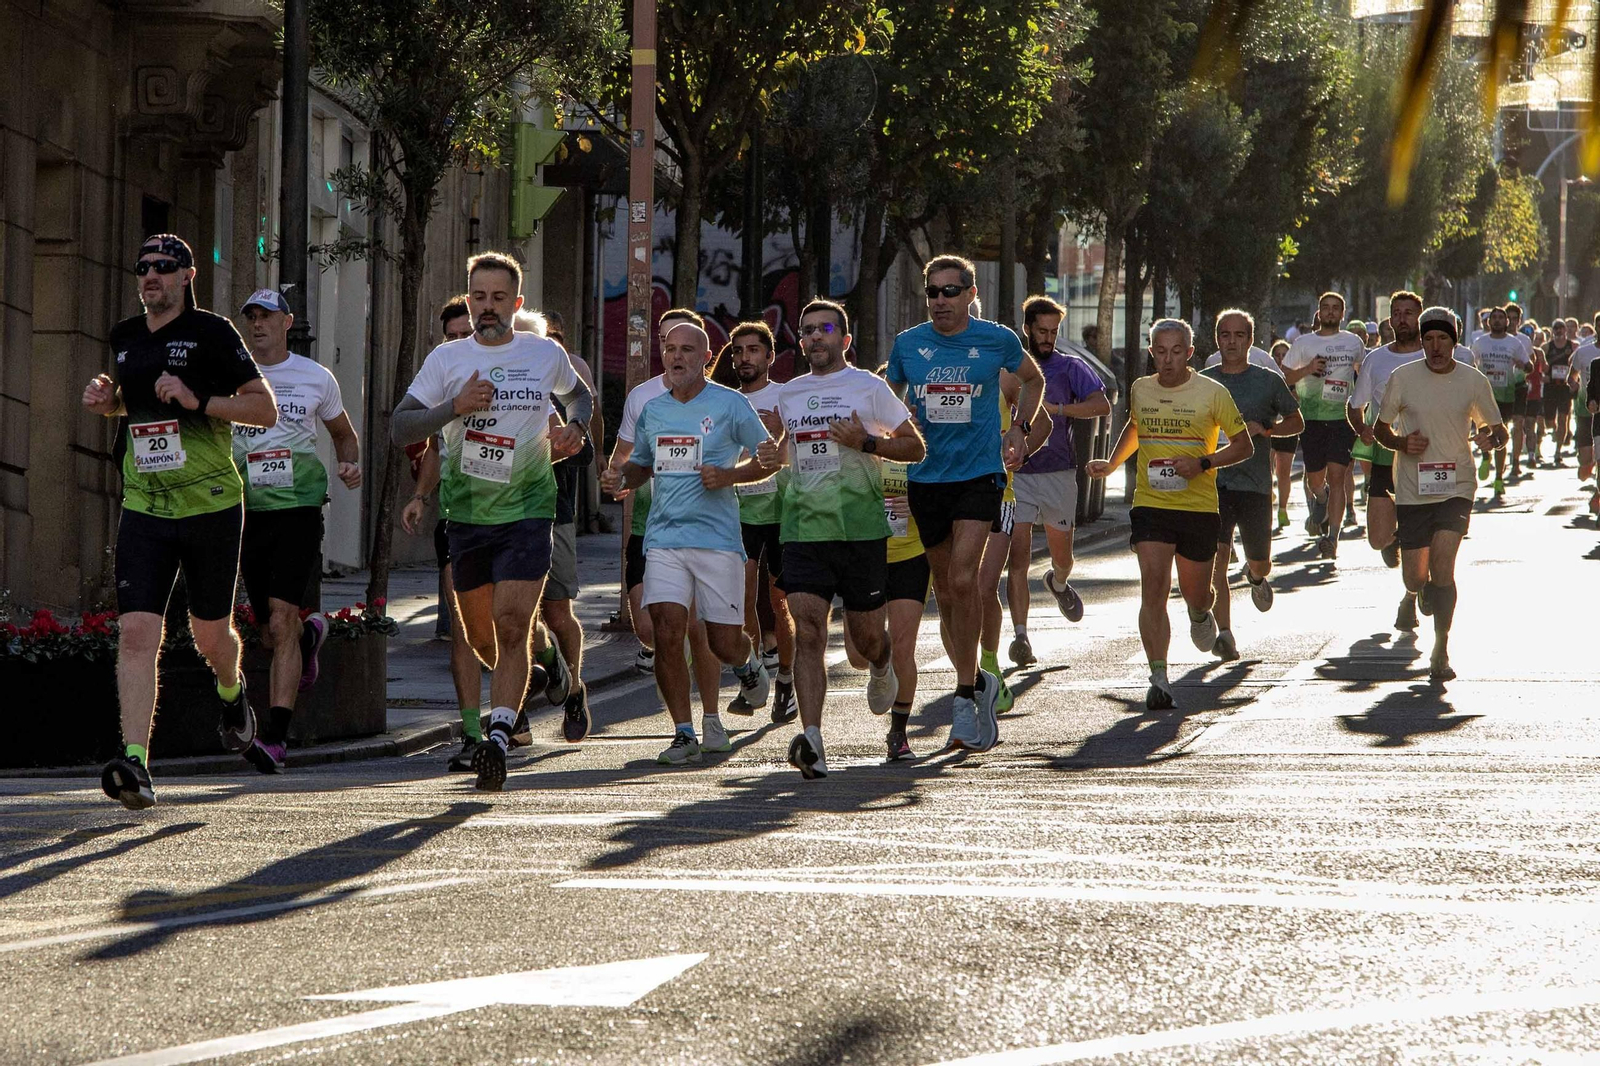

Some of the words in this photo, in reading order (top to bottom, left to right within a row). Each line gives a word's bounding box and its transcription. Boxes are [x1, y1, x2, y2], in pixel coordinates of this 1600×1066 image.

[926, 366, 971, 382] 42K
[940, 395, 964, 406] 259
[491, 404, 500, 412] el
[501, 403, 532, 411] cáncer
[463, 415, 497, 431] Vigo
[1141, 417, 1191, 427] ATHLETICS
[148, 437, 168, 451] 20
[812, 442, 828, 454] 83
[479, 446, 505, 461] 319
[669, 447, 688, 457] 199
[262, 461, 287, 472] 294
[1160, 468, 1180, 477] 43
[1434, 471, 1448, 481] 33
[884, 510, 897, 521] 75
